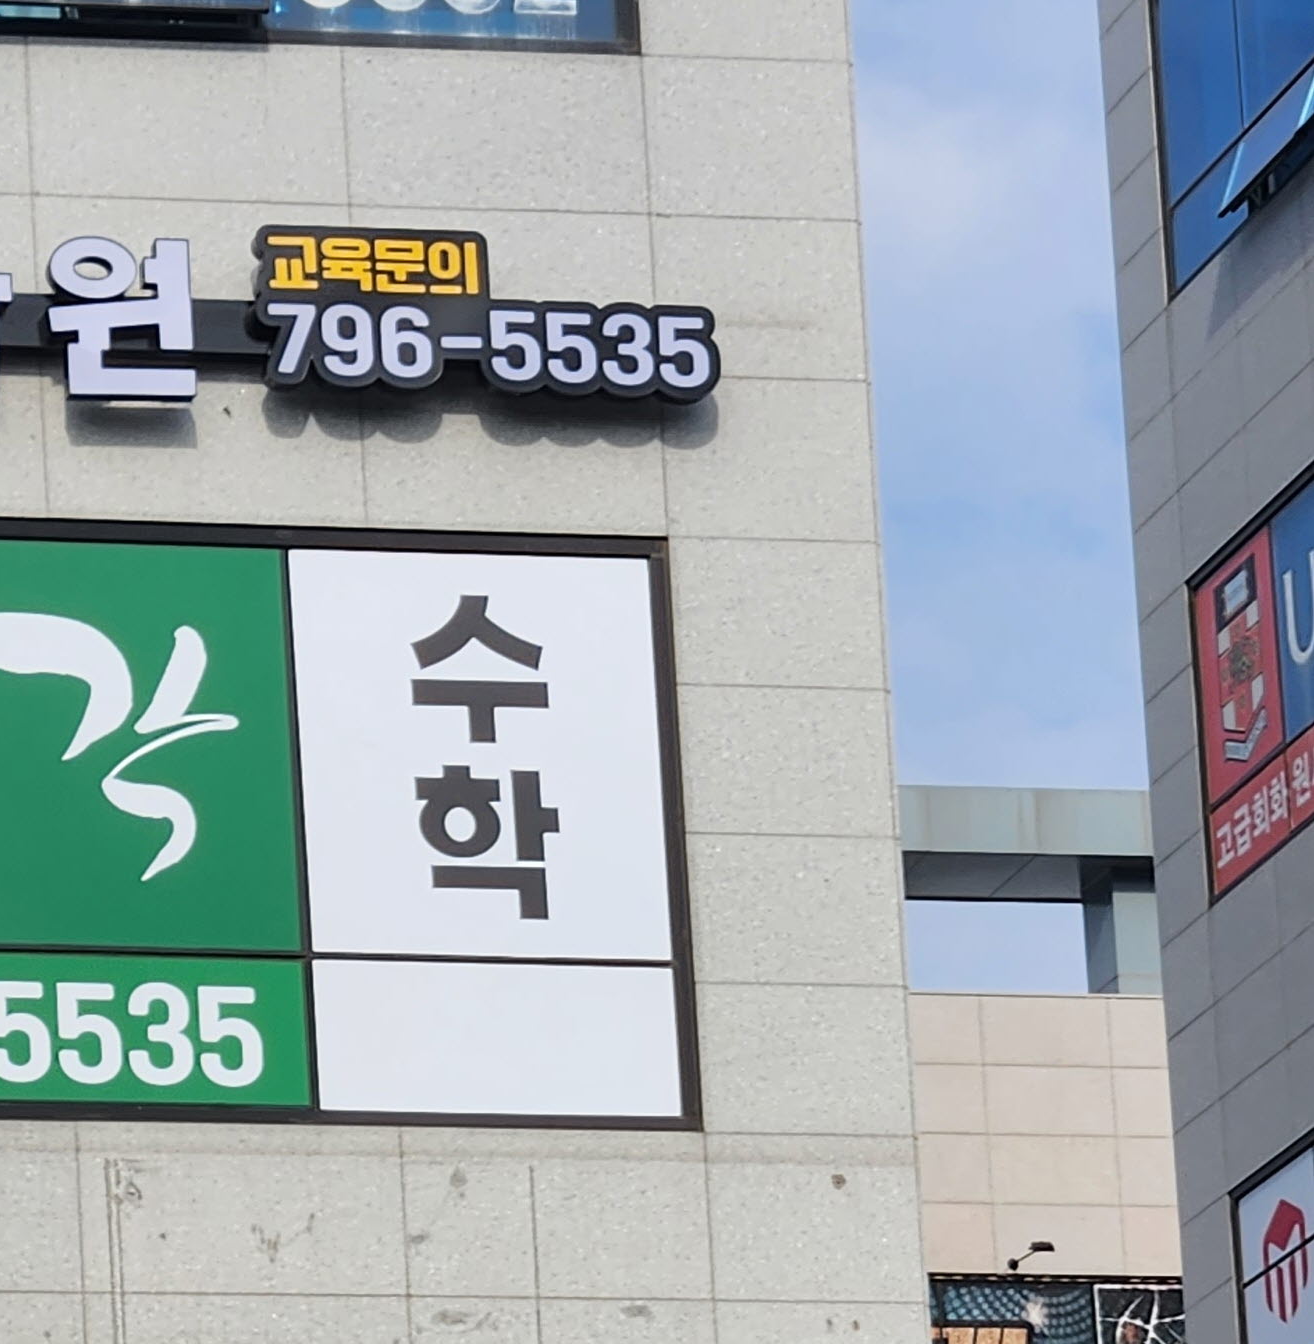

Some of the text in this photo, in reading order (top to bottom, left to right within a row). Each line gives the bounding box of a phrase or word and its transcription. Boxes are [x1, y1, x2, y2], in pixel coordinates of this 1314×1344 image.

[267, 235, 480, 295] 교육문의
[267, 303, 712, 388] 796-5535
[410, 594, 561, 921] 수학
[1216, 770, 1288, 869] 고급회화
